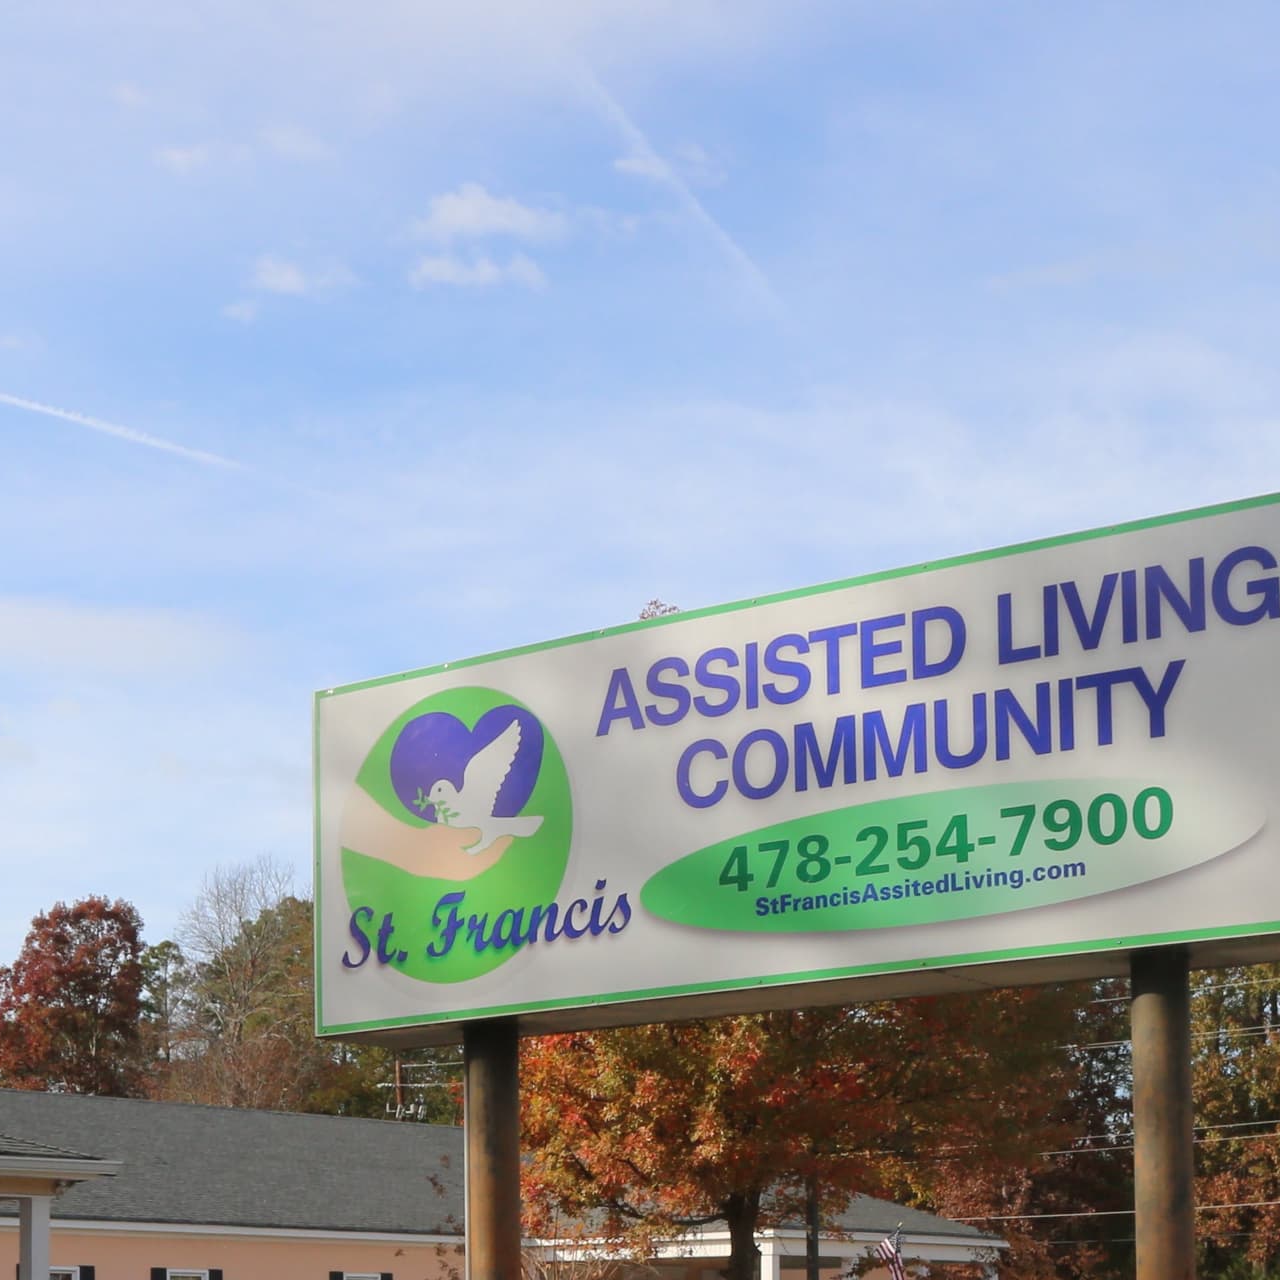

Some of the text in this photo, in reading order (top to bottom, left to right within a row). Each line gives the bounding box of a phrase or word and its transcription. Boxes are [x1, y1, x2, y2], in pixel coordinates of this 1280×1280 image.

[595, 605, 968, 738] ASSISTED
[676, 658, 1186, 809] COMMUNITY
[718, 786, 1174, 893] 478-254-7900
[754, 861, 1087, 917] StFrancisAssitedLiving.com
[341, 878, 632, 969] St. Francis
